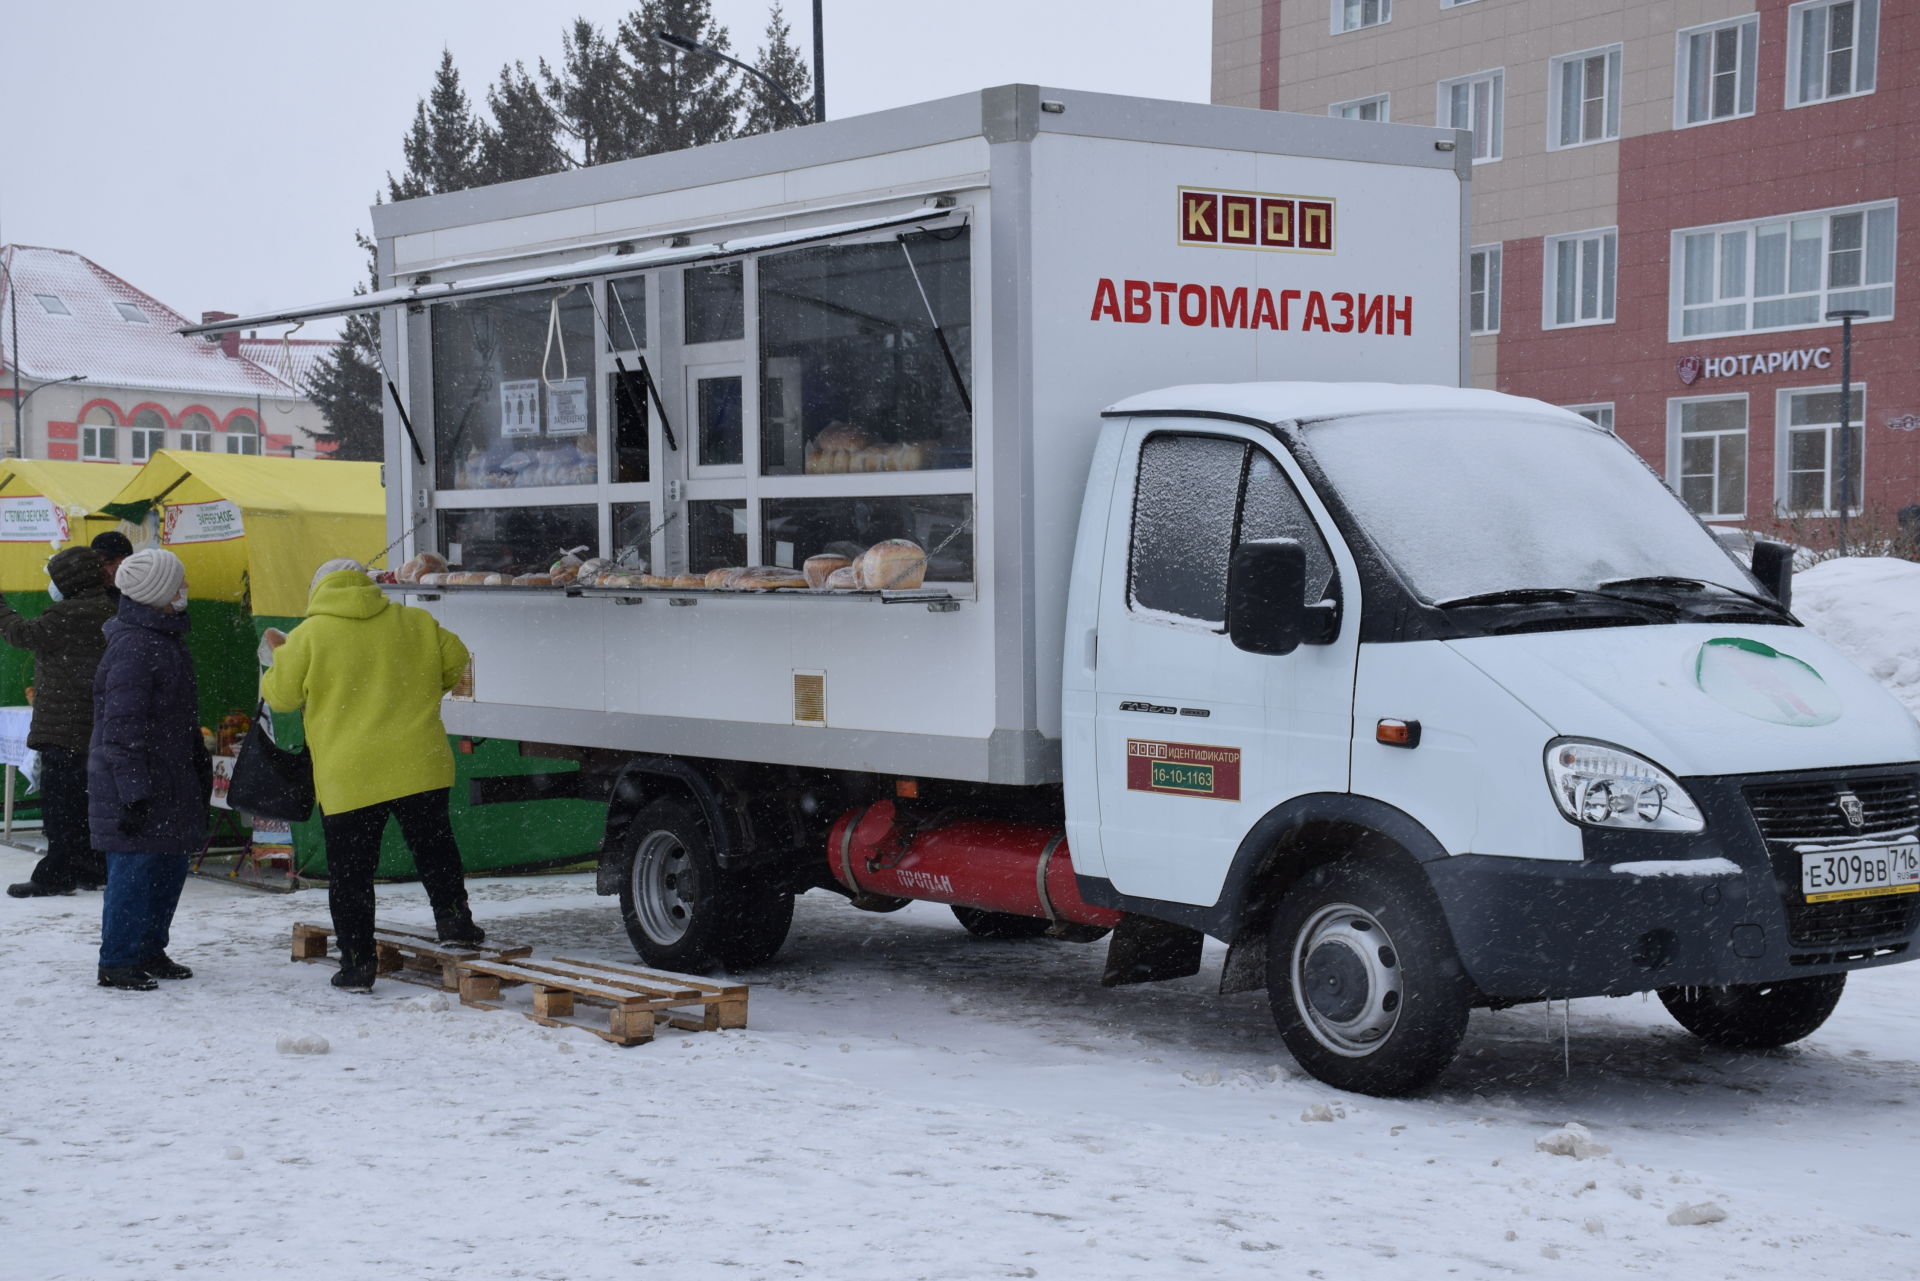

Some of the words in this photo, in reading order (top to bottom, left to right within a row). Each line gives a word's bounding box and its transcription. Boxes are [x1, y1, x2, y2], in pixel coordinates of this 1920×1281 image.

[1187, 199, 1328, 244] КООП
[1090, 277, 1413, 337] АВТОМАГАЗИН
[1704, 347, 1832, 378] НОТАРИУС
[1129, 743, 1166, 757] КООП
[1168, 747, 1240, 763] ИДЕНТИФИКАТОР
[1153, 768, 1212, 786] 16-10-1163
[896, 869, 954, 893] ПРОПАН
